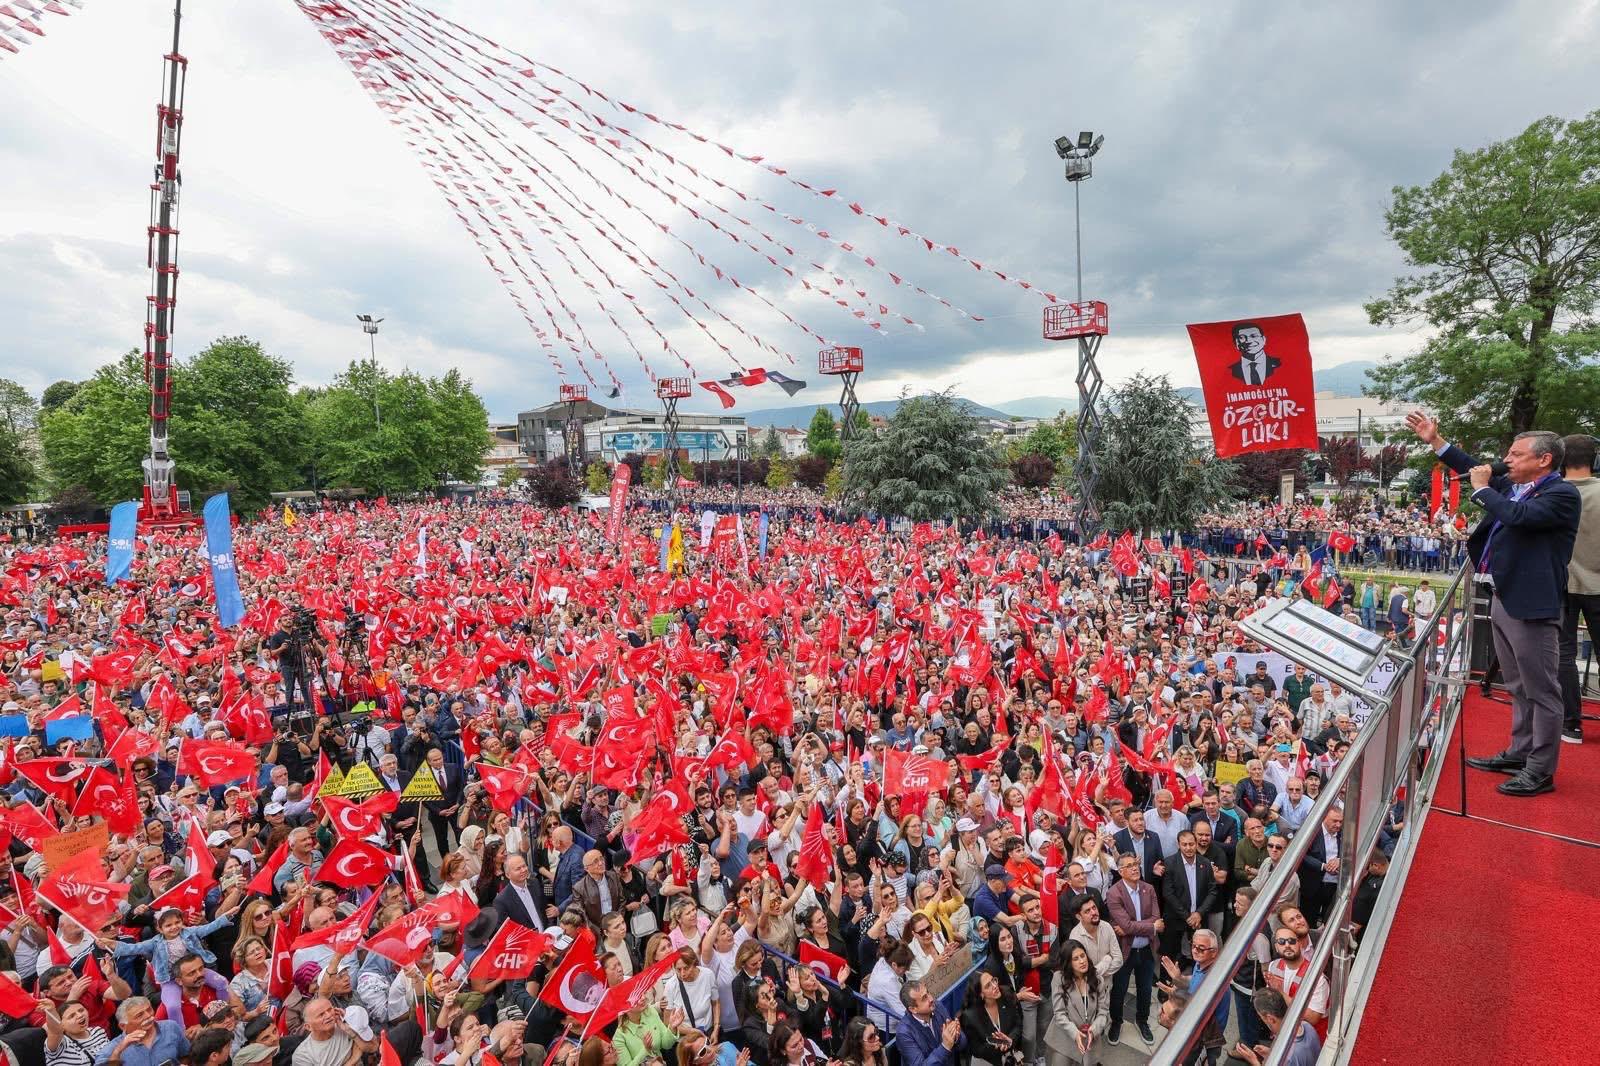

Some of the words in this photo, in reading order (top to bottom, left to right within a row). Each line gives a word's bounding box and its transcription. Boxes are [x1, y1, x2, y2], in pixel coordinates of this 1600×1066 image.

[1226, 388, 1288, 403] İMAMOĞLU'NA
[1223, 397, 1305, 429] ÖZGÜR-
[1241, 421, 1289, 448] LÜK!
[211, 553, 233, 566] SOL
[902, 776, 930, 788] CHP
[494, 952, 530, 969] CHP
